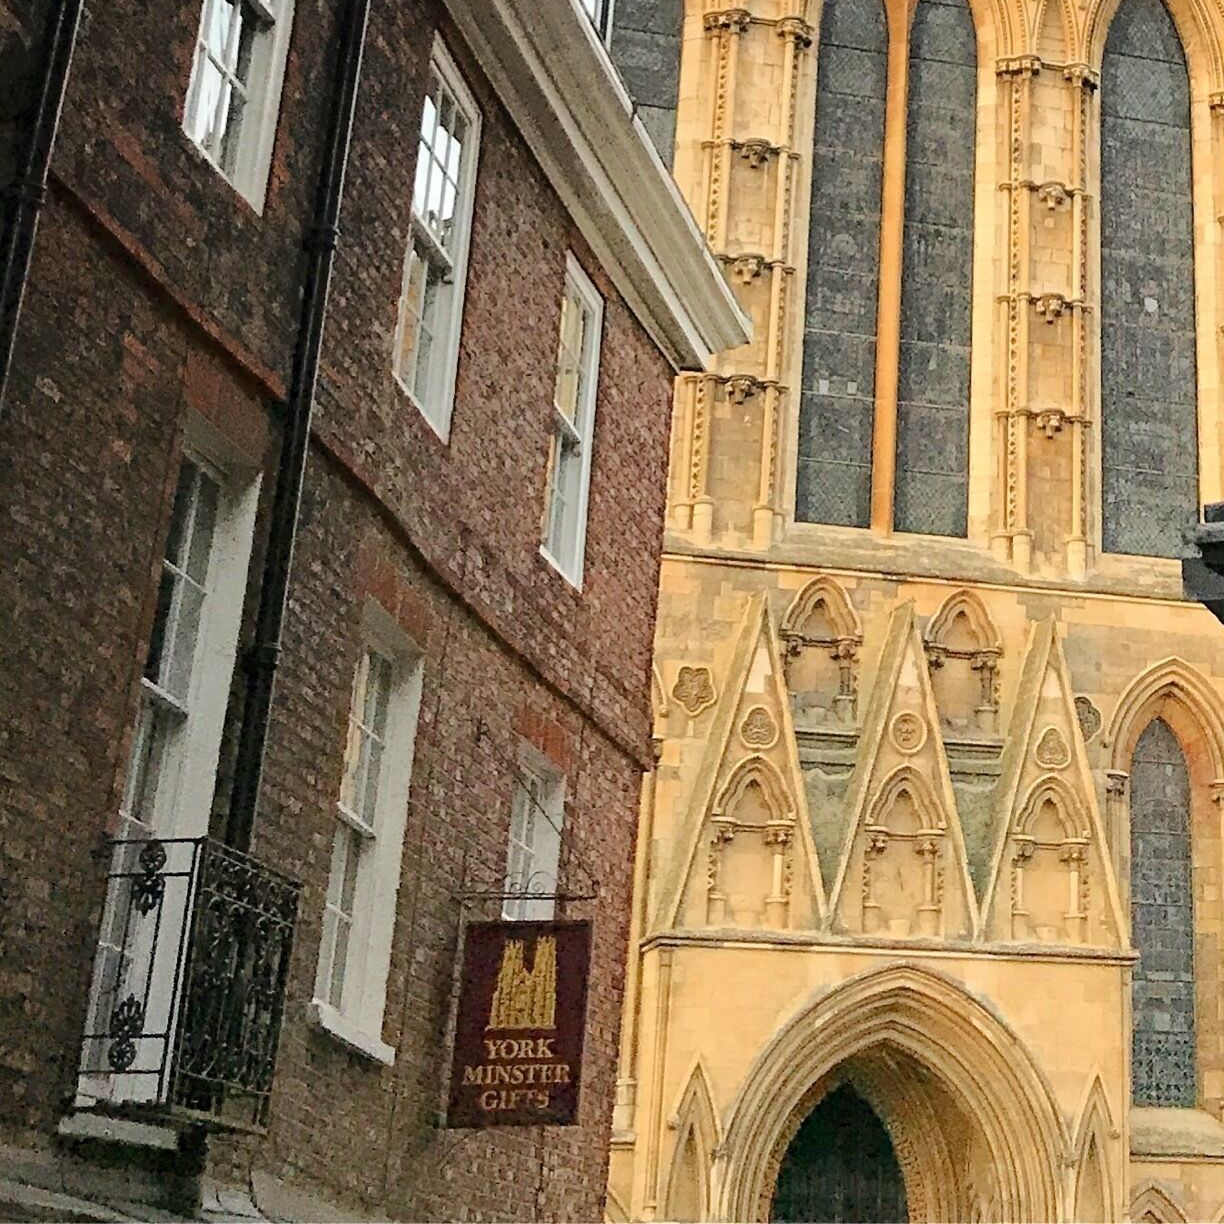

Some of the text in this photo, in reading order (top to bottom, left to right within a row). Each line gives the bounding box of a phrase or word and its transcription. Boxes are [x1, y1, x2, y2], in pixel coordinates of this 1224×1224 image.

[484, 1039, 556, 1060] YORK
[462, 1064, 571, 1086] MINSTER
[481, 1090, 550, 1110] GIFTS
